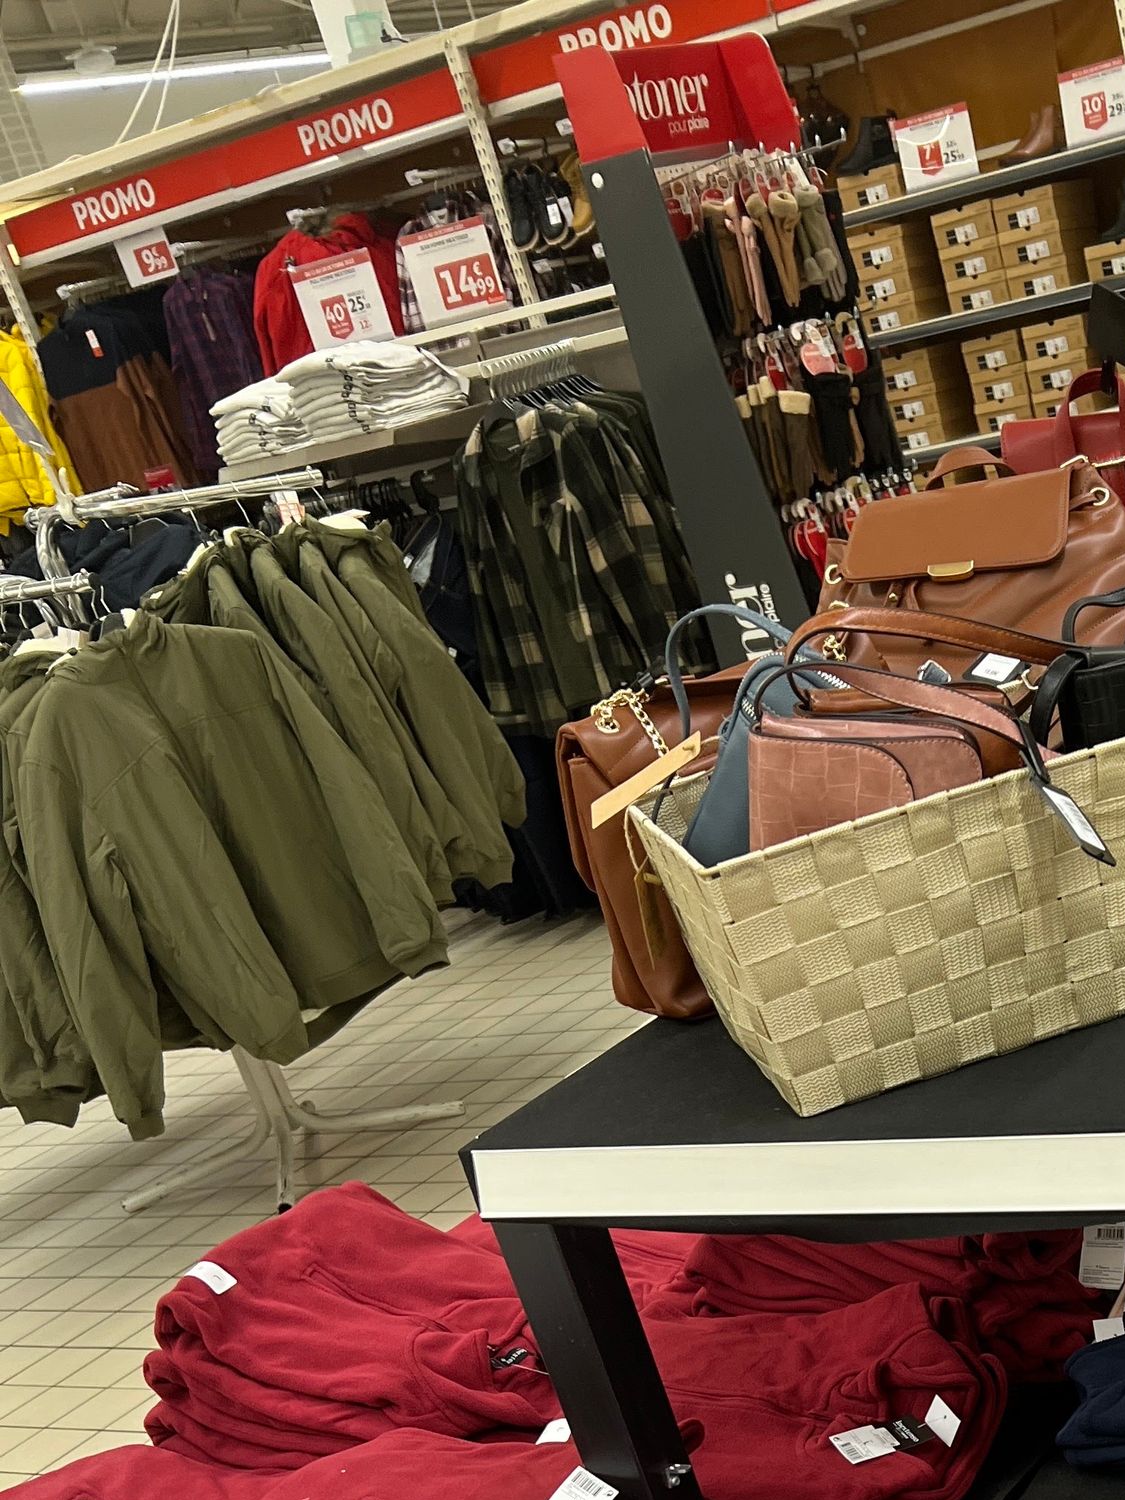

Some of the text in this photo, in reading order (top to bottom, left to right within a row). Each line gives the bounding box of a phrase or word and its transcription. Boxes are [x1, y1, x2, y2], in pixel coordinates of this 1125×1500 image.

[297, 99, 394, 156] PROMO
[668, 116, 710, 137] pour plaire
[72, 178, 156, 230] PROMO
